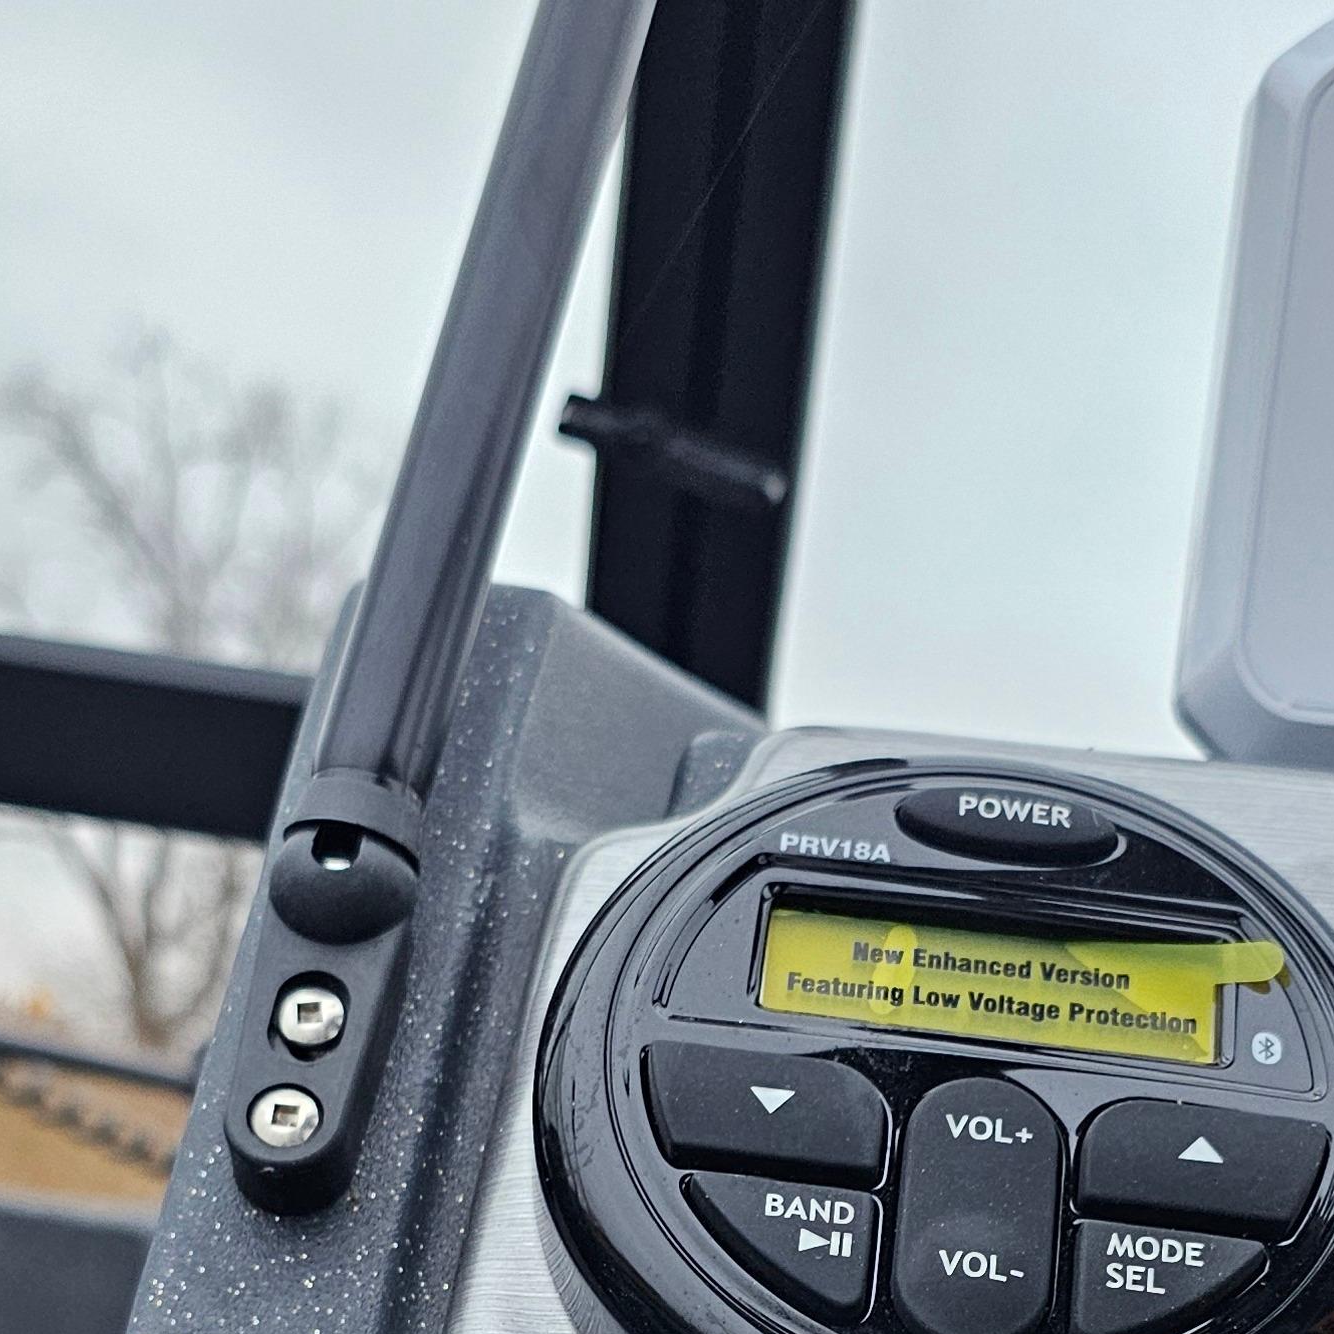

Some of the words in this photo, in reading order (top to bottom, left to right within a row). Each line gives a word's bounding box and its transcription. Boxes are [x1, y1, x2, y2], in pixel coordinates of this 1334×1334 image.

[957, 795, 1073, 830] POWER
[779, 832, 891, 863] PRV18A
[852, 941, 904, 966] New
[912, 948, 1032, 980] Enhanced
[1040, 962, 1131, 991] Version
[786, 971, 905, 1008] Featuring
[912, 985, 961, 1010] Low
[968, 989, 1061, 1022] Voltage
[1068, 1004, 1198, 1036] Protection
[945, 1113, 1034, 1146] VOL+
[764, 1193, 855, 1225] BAND
[938, 1249, 1025, 1282] VOL-
[1106, 1232, 1206, 1268] MODE
[1106, 1263, 1167, 1296] SEL
